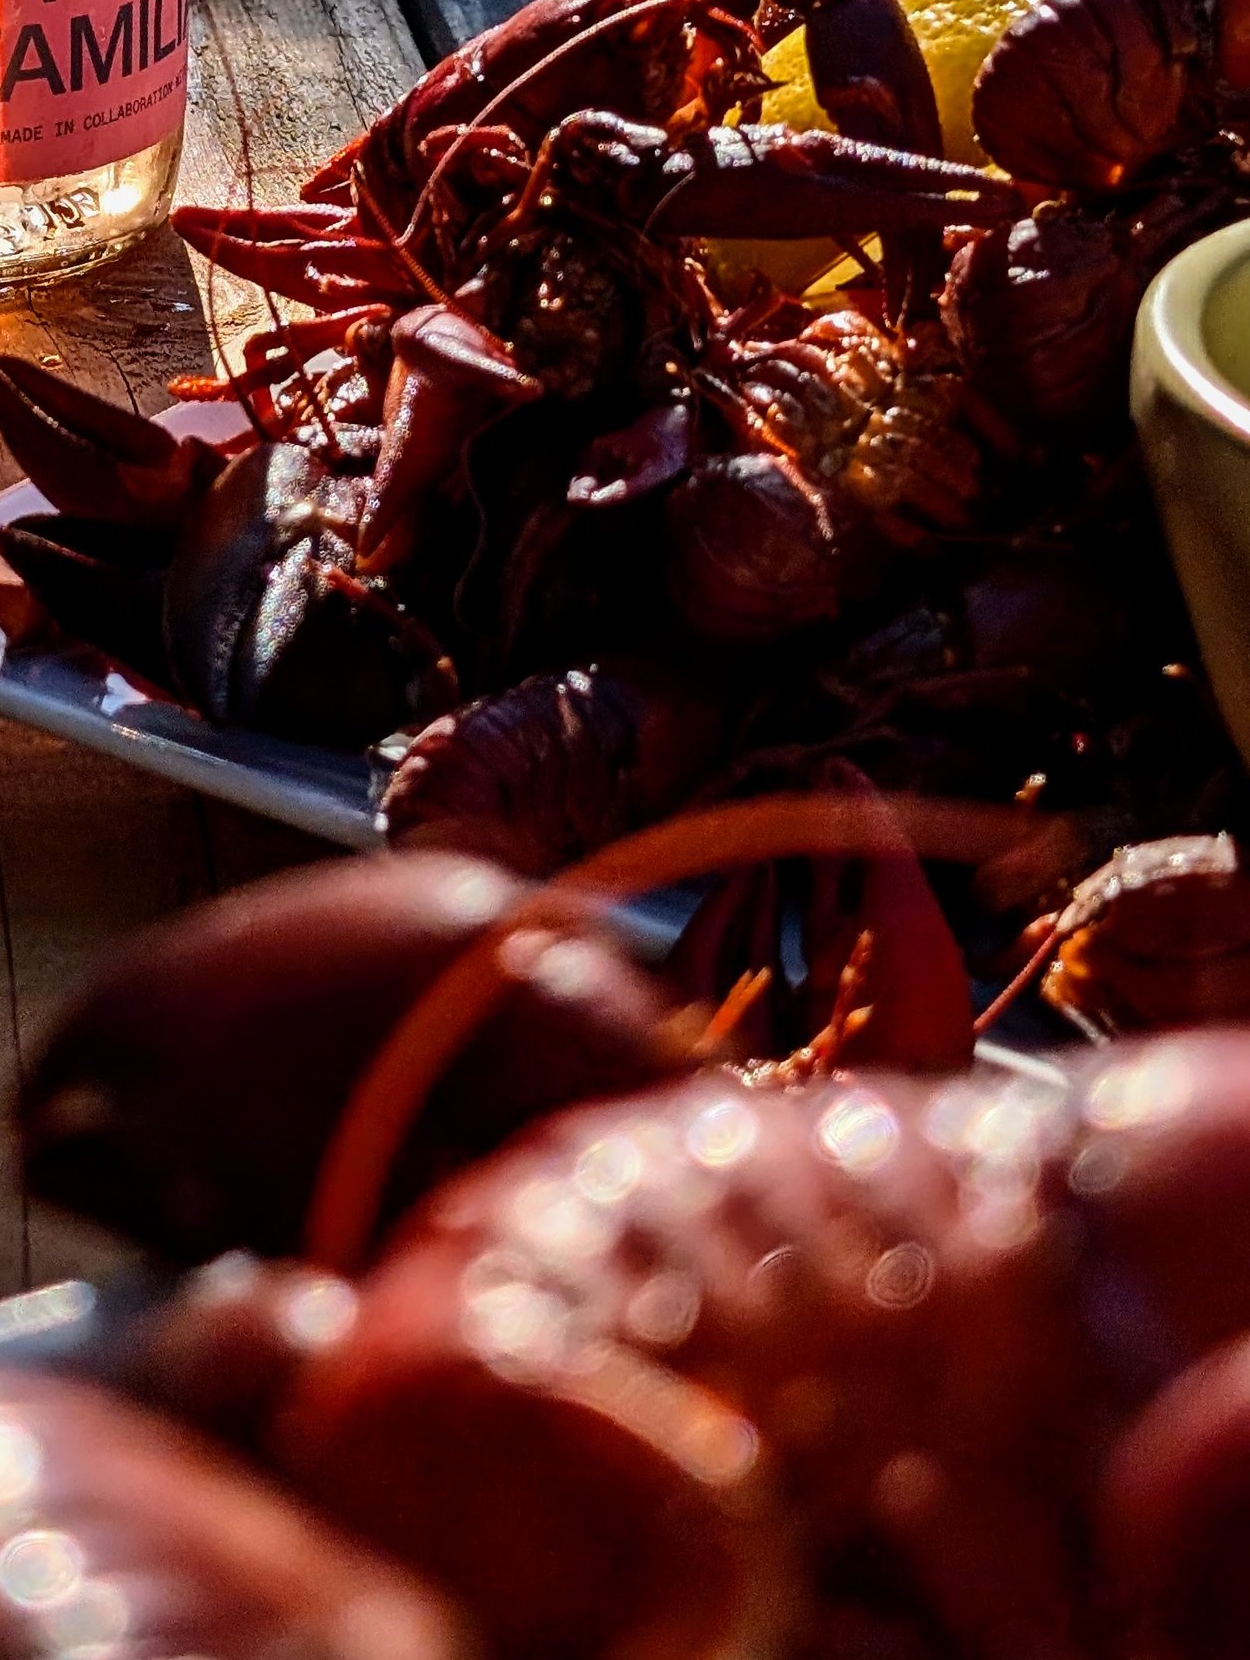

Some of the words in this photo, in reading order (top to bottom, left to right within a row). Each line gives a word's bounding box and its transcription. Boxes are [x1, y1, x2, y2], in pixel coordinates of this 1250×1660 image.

[0, 125, 44, 144] MADE
[55, 120, 75, 138] IN
[84, 81, 173, 131] COLLABORATION
